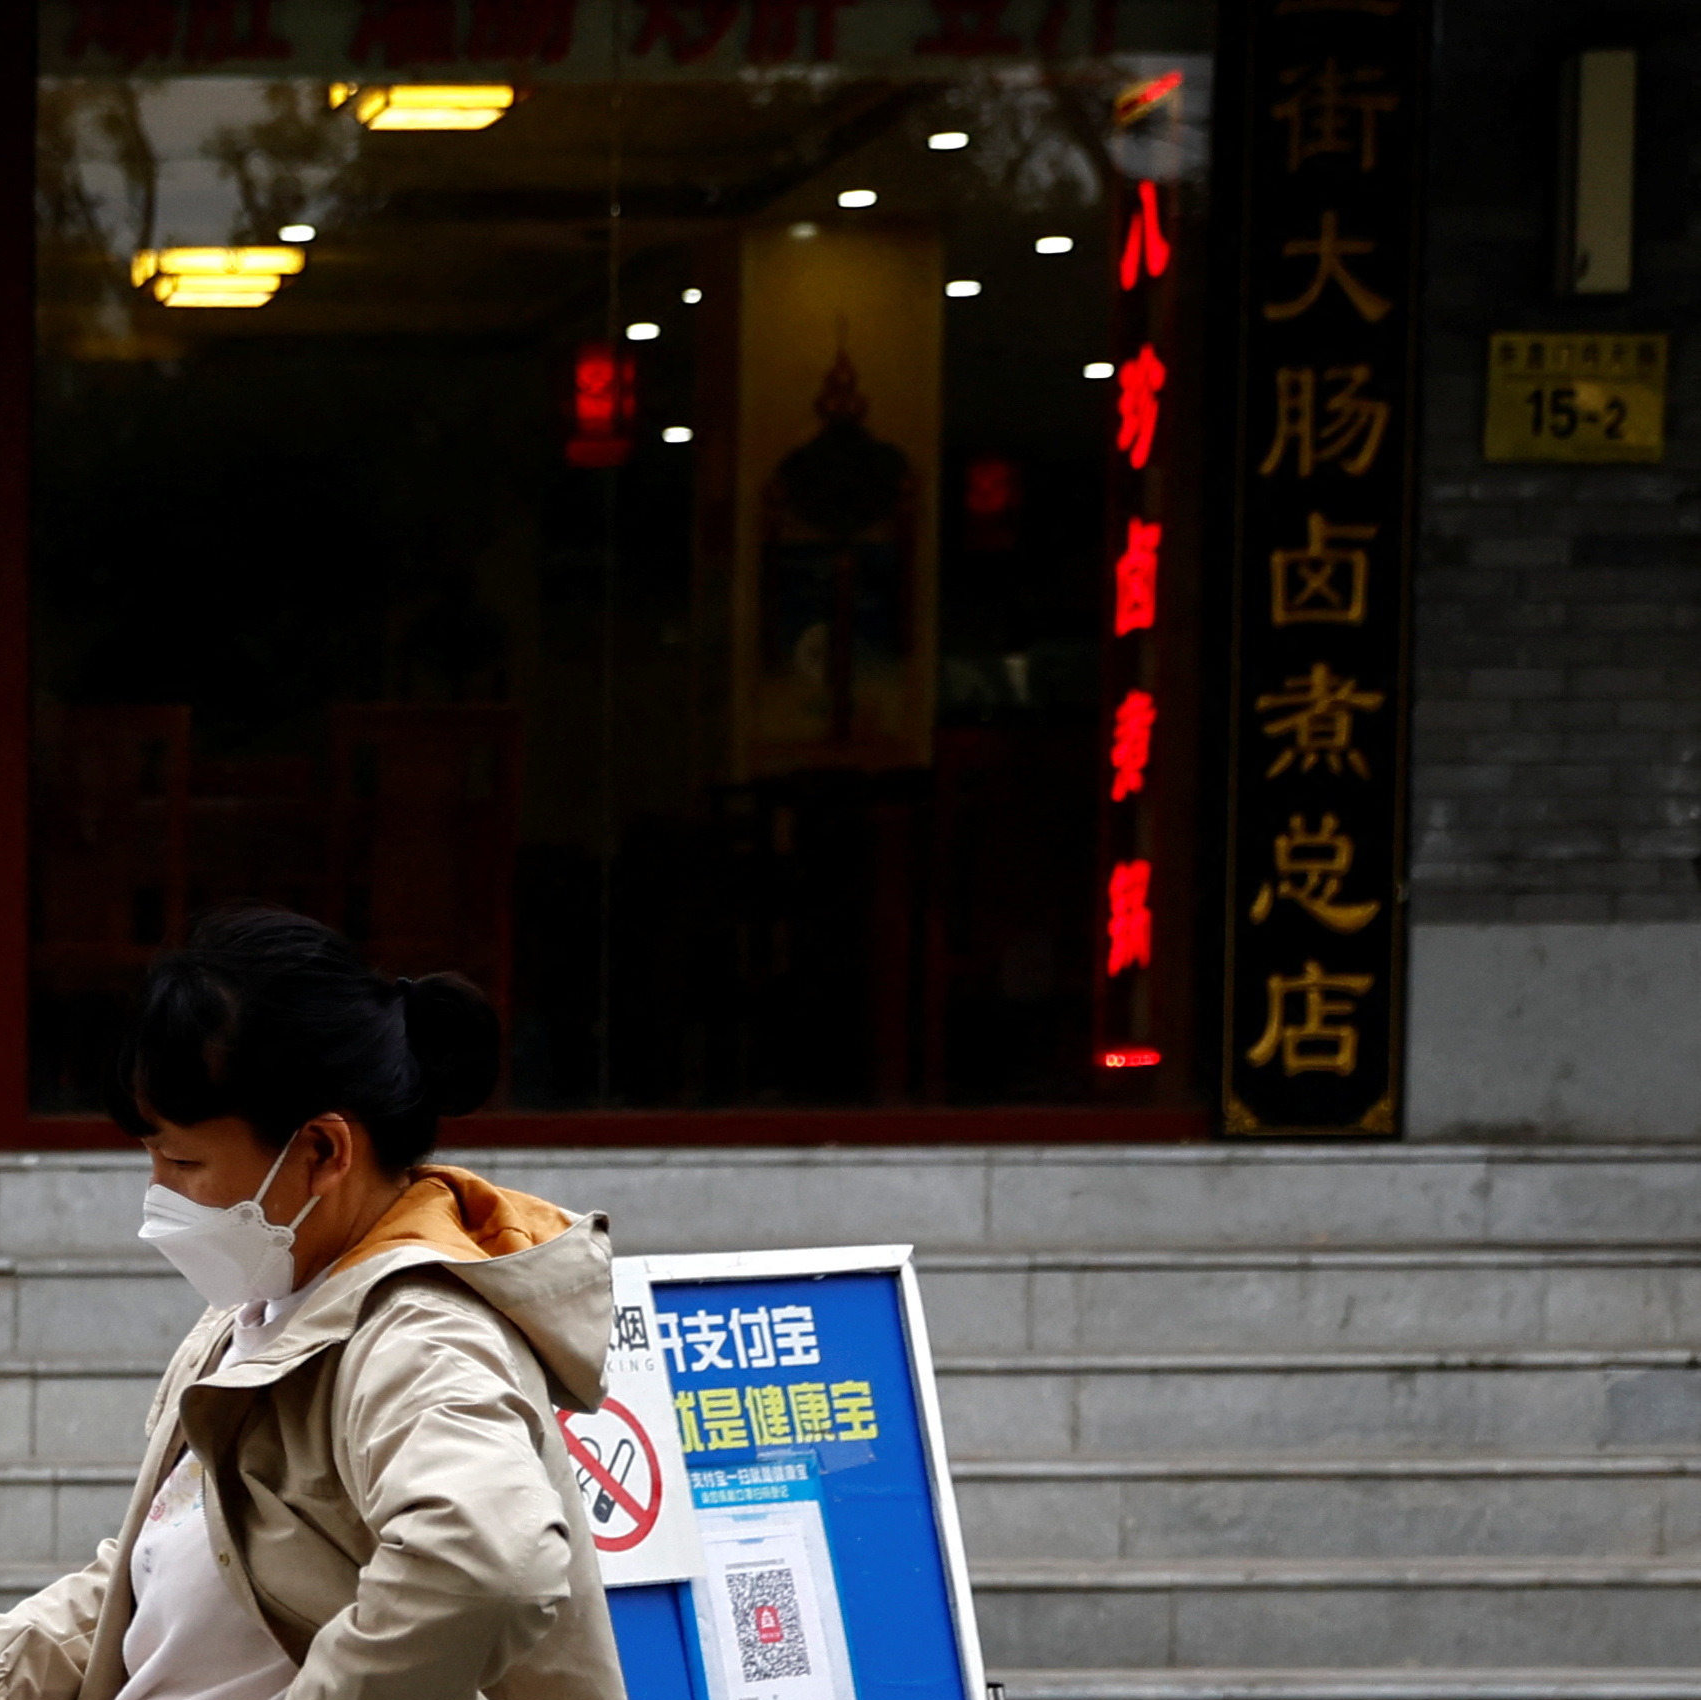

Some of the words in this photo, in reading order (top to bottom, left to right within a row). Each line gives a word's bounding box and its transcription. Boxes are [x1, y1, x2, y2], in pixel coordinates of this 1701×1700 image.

[1527, 387, 1628, 440] 15-2
[1247, 0, 1405, 1078] 街大肠卤煮总店
[608, 1304, 650, 1352] 烟
